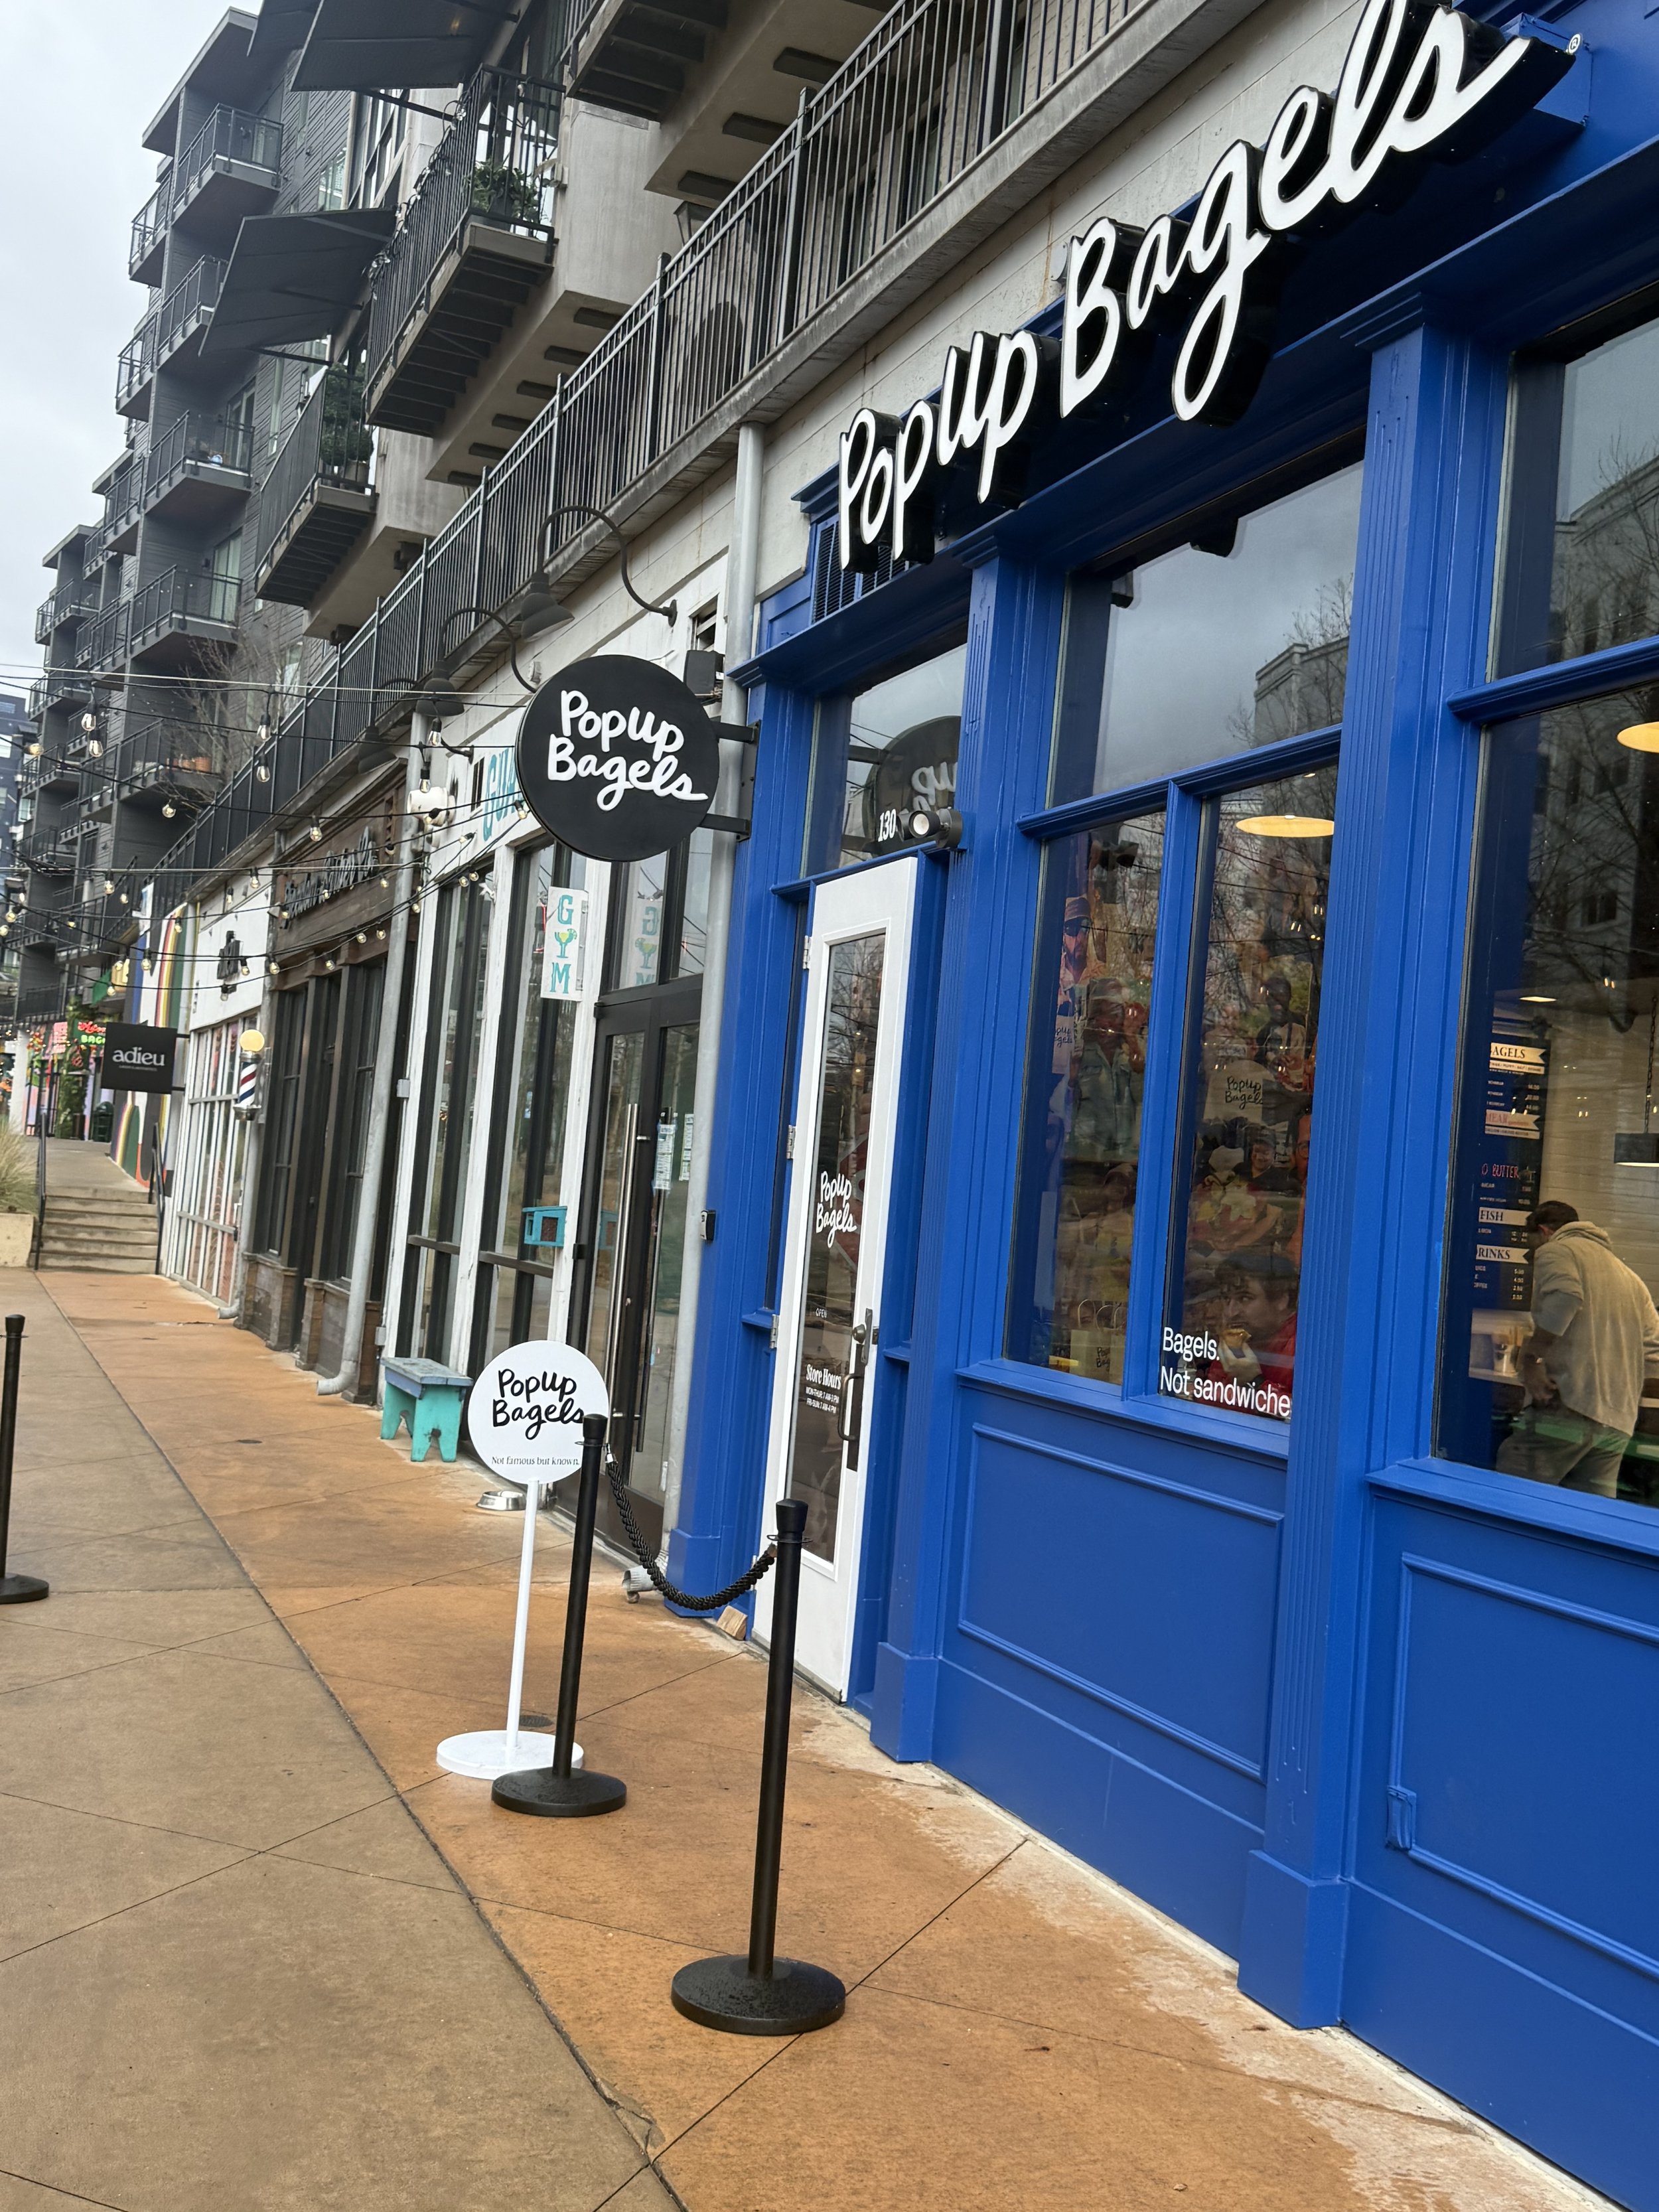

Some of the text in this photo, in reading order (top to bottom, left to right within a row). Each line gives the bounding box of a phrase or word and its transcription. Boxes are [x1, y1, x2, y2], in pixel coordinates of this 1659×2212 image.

[1060, 0, 1533, 421] Bagels
[547, 734, 709, 811] Bagels
[484, 748, 522, 842] GUA
[878, 808, 897, 842] 130
[112, 1047, 165, 1067] adieu
[1492, 1046, 1526, 1059] AGELS
[1492, 1163, 1519, 1178] BUTTER
[816, 1202, 857, 1248] Bagels
[1480, 1210, 1504, 1221] FISH
[1478, 1248, 1510, 1260] RINKS
[816, 1307, 828, 1318] OPEN
[1163, 1327, 1220, 1362] Bagels.
[806, 1364, 841, 1390] Store Hours
[1160, 1366, 1291, 1417] Not sandwiche
[493, 1398, 584, 1440] Bagels
[492, 1456, 504, 1465] Not
[505, 1455, 536, 1465] famous
[537, 1456, 550, 1465] but
